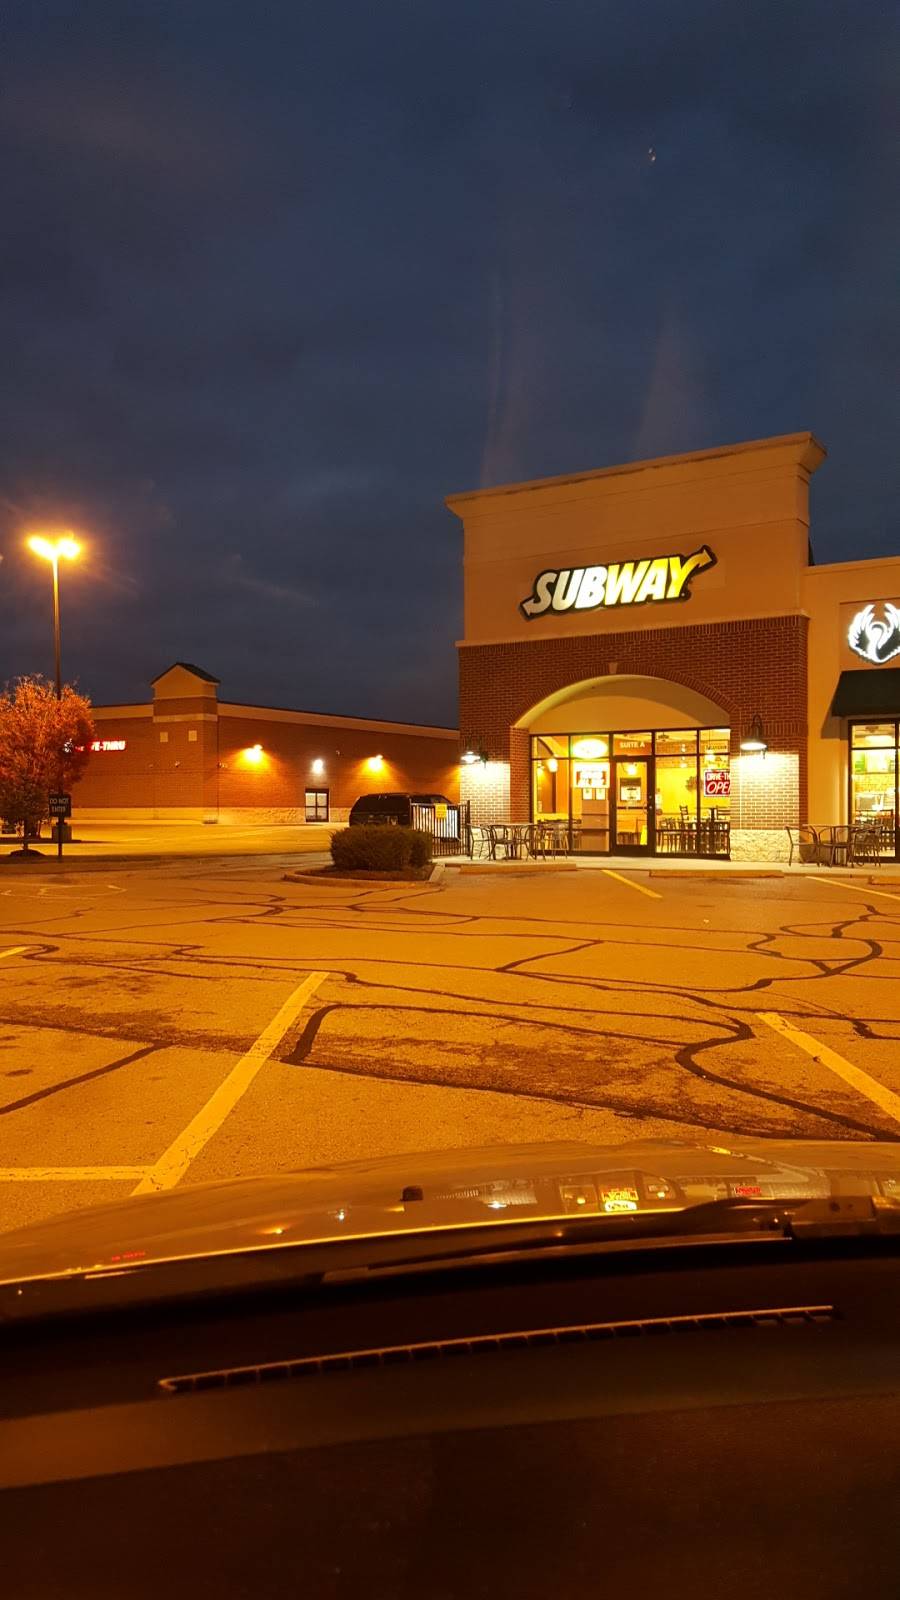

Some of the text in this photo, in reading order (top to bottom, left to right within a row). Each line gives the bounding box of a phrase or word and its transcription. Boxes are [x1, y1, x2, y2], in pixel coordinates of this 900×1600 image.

[523, 549, 712, 615] SUBWAY
[619, 741, 638, 749] SUITE
[49, 797, 69, 805] DO NOT
[51, 805, 66, 813] ENTER
